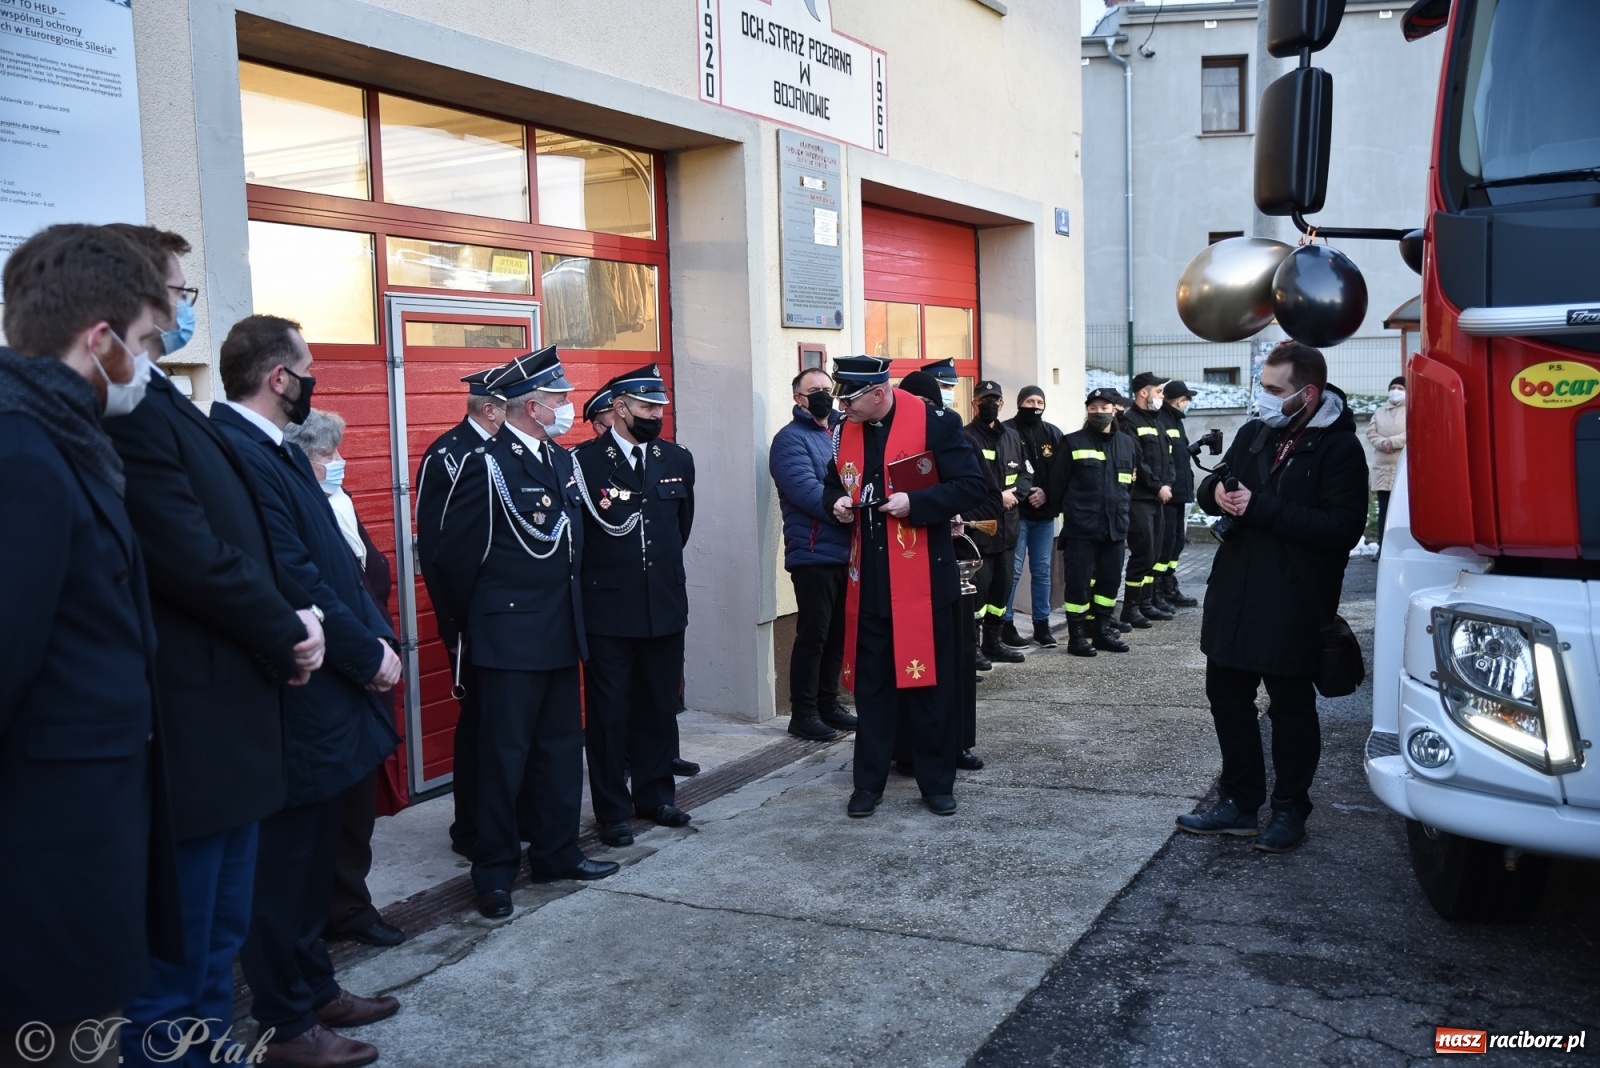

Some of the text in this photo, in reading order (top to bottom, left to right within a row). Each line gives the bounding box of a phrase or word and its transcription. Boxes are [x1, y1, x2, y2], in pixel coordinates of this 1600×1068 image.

[34, 2, 58, 15] HELP
[0, 9, 83, 37] wspólnej ochrony
[14, 26, 23, 34] w
[26, 27, 83, 48] Euroregionie
[799, 61, 811, 87] W
[773, 80, 831, 120] BOJANOWIE
[1518, 377, 1599, 397] bocar
